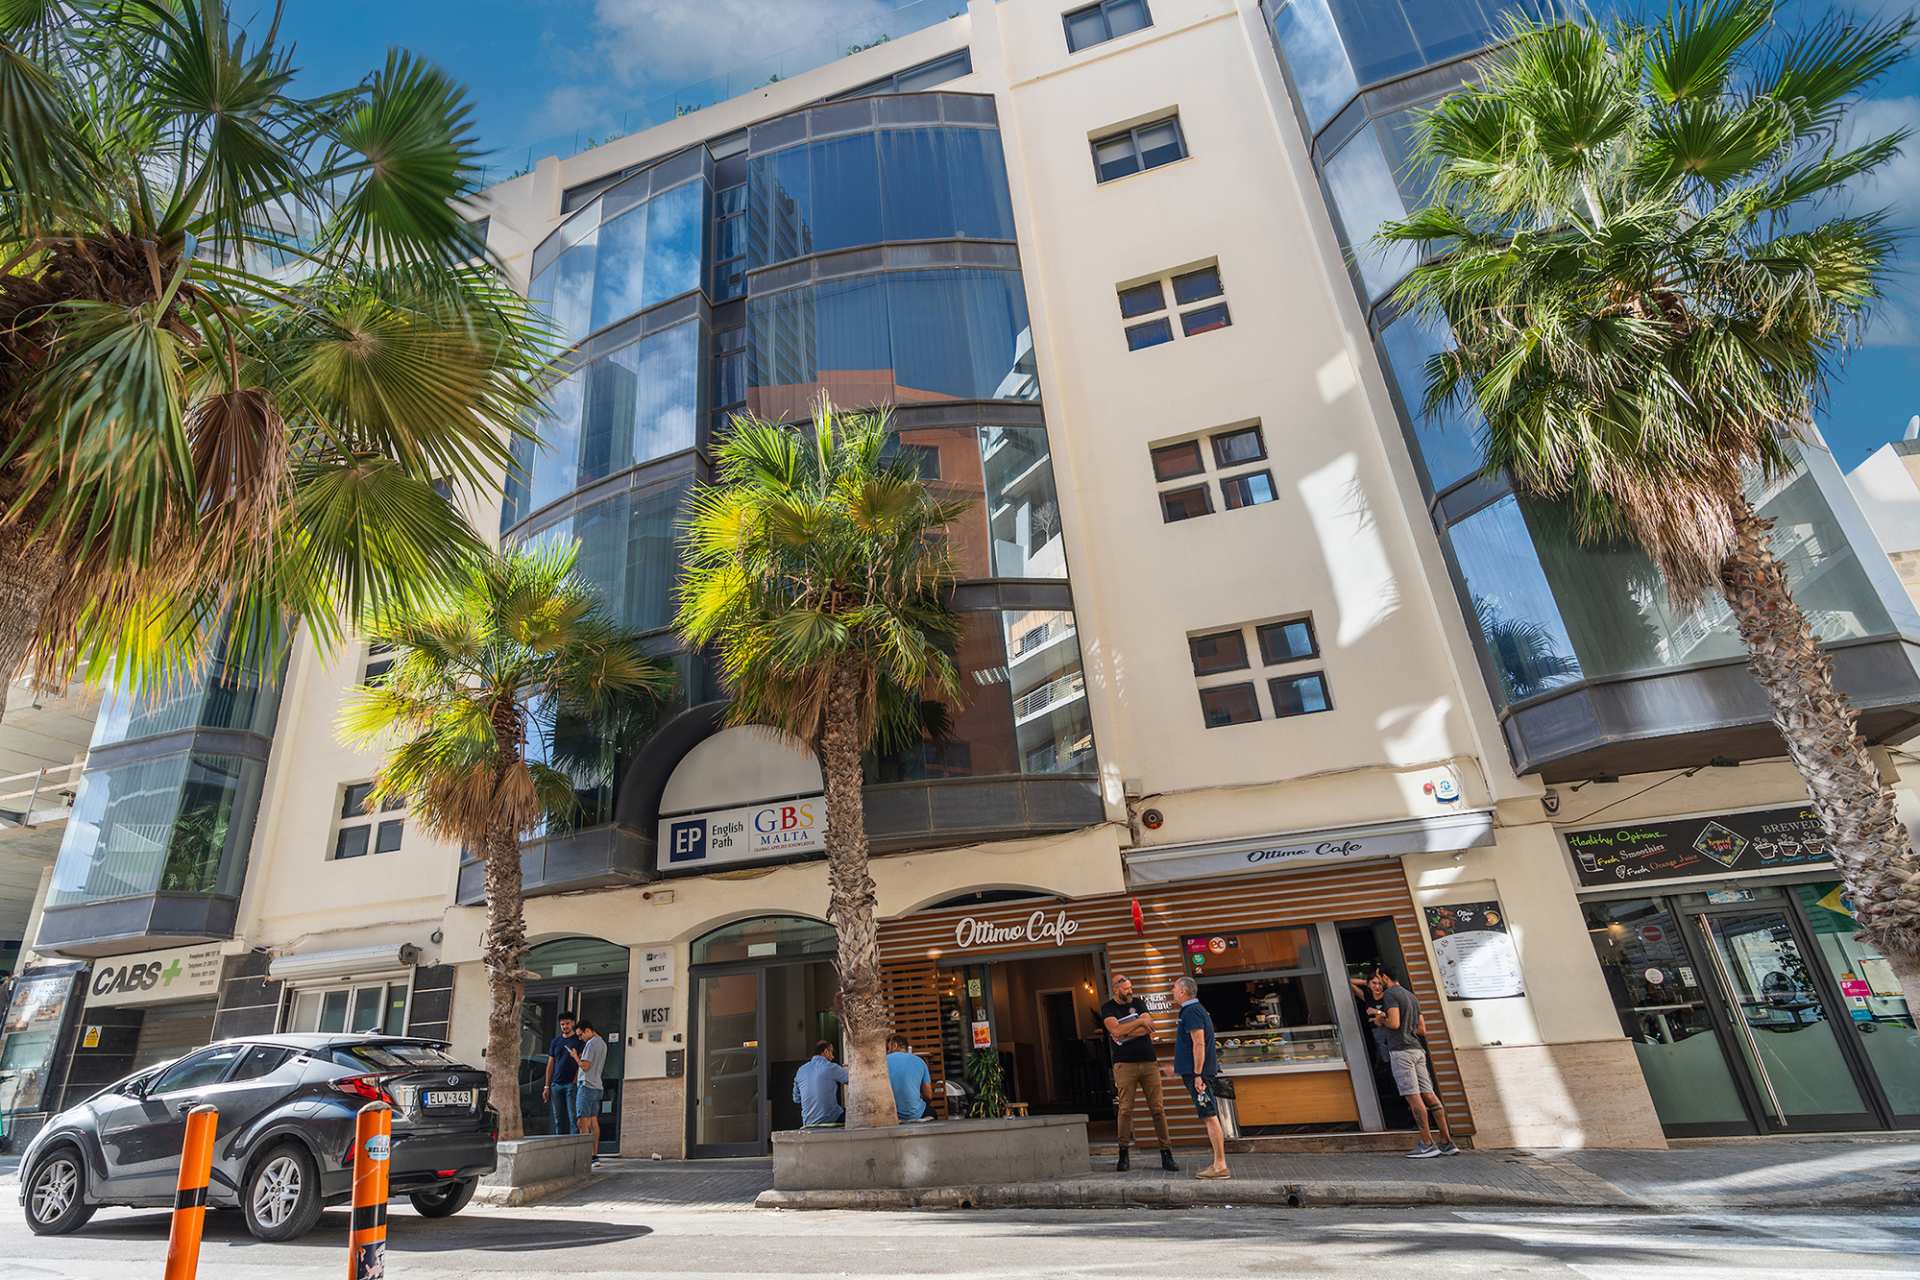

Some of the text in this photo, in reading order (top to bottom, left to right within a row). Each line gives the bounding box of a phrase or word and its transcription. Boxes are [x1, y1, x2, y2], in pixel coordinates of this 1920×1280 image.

[754, 802, 816, 833] GBS
[712, 821, 744, 838] English
[1761, 819, 1821, 835] BREWED
[676, 826, 702, 854] EP
[712, 836, 733, 849] Path
[760, 830, 808, 846] MALTA
[1569, 832, 1613, 847] Healthy
[1246, 841, 1363, 863] Ottimo Cafe
[1619, 843, 1665, 860] Smoothies
[1626, 864, 1650, 877] Fresh
[955, 910, 1079, 948] Ottimo Cafe
[649, 965, 665, 973] WEST
[642, 1007, 670, 1024] WEST
